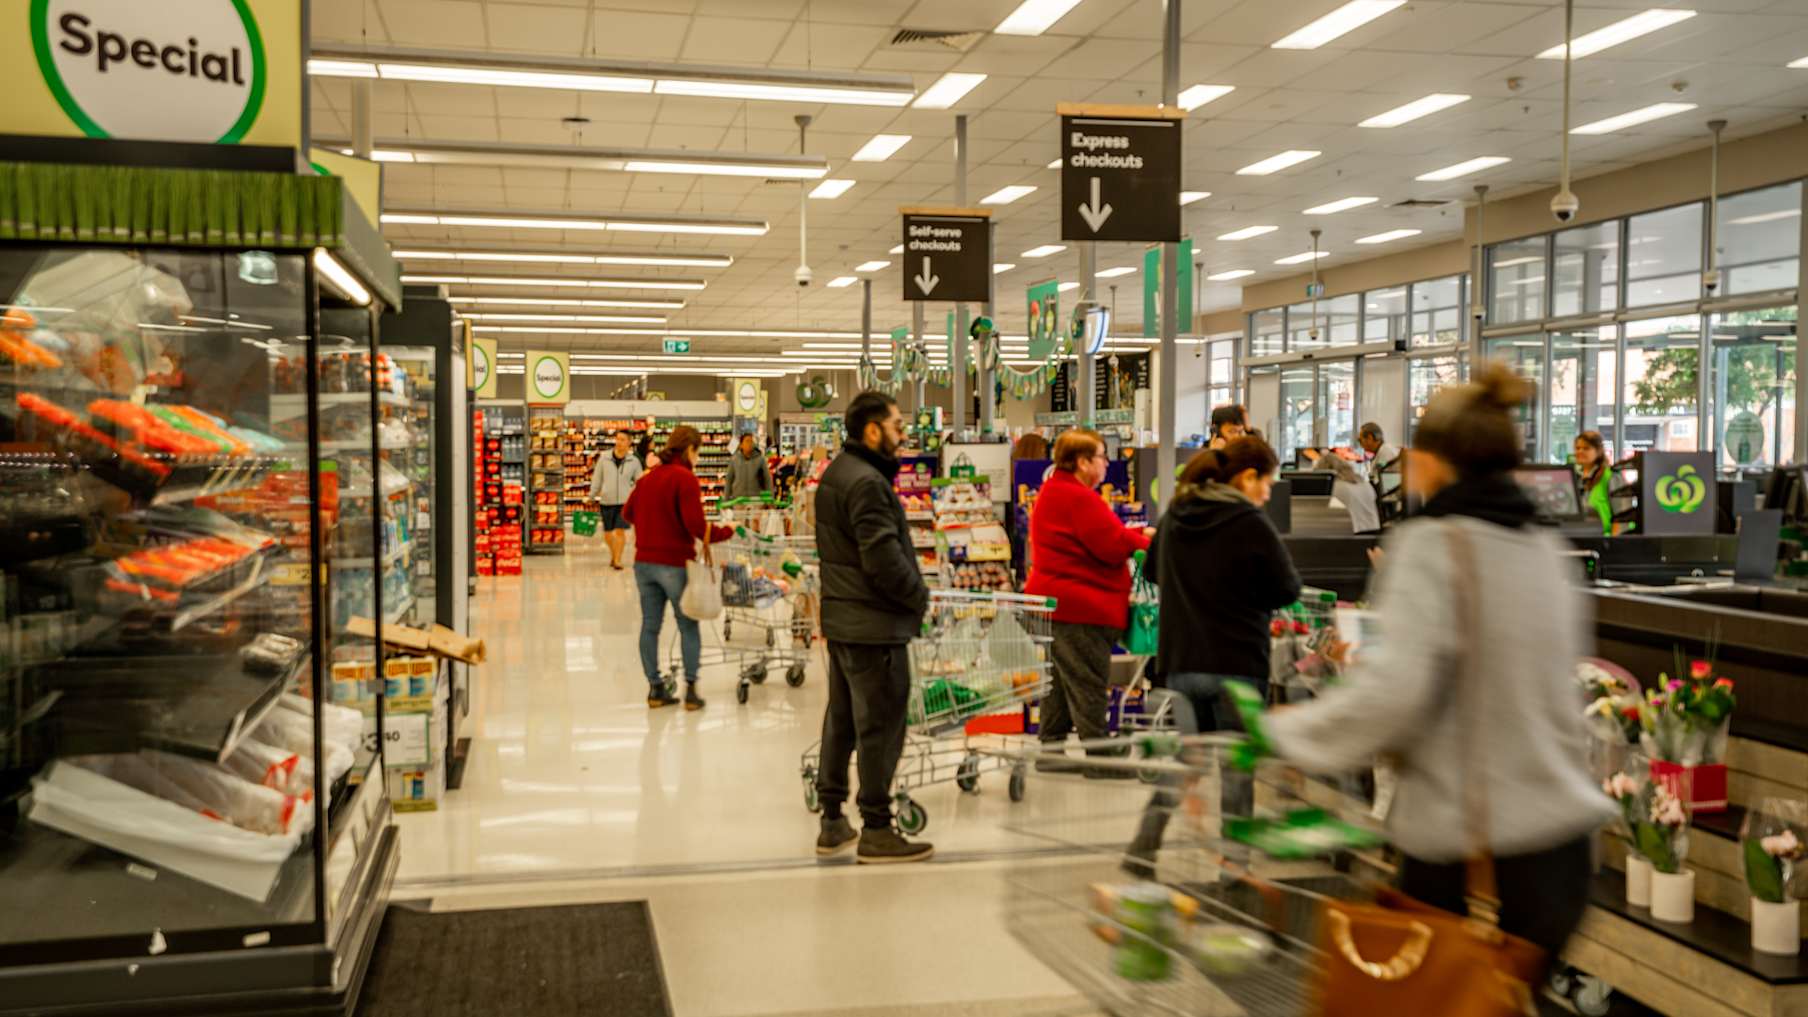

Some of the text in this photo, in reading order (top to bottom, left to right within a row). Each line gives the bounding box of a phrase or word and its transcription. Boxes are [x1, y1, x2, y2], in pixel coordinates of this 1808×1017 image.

[59, 12, 245, 86] Special
[1071, 131, 1130, 151] Express
[1071, 152, 1144, 168] checkouts
[909, 225, 962, 238] Self-serve
[909, 239, 962, 251] checkouts
[536, 373, 562, 383] Special
